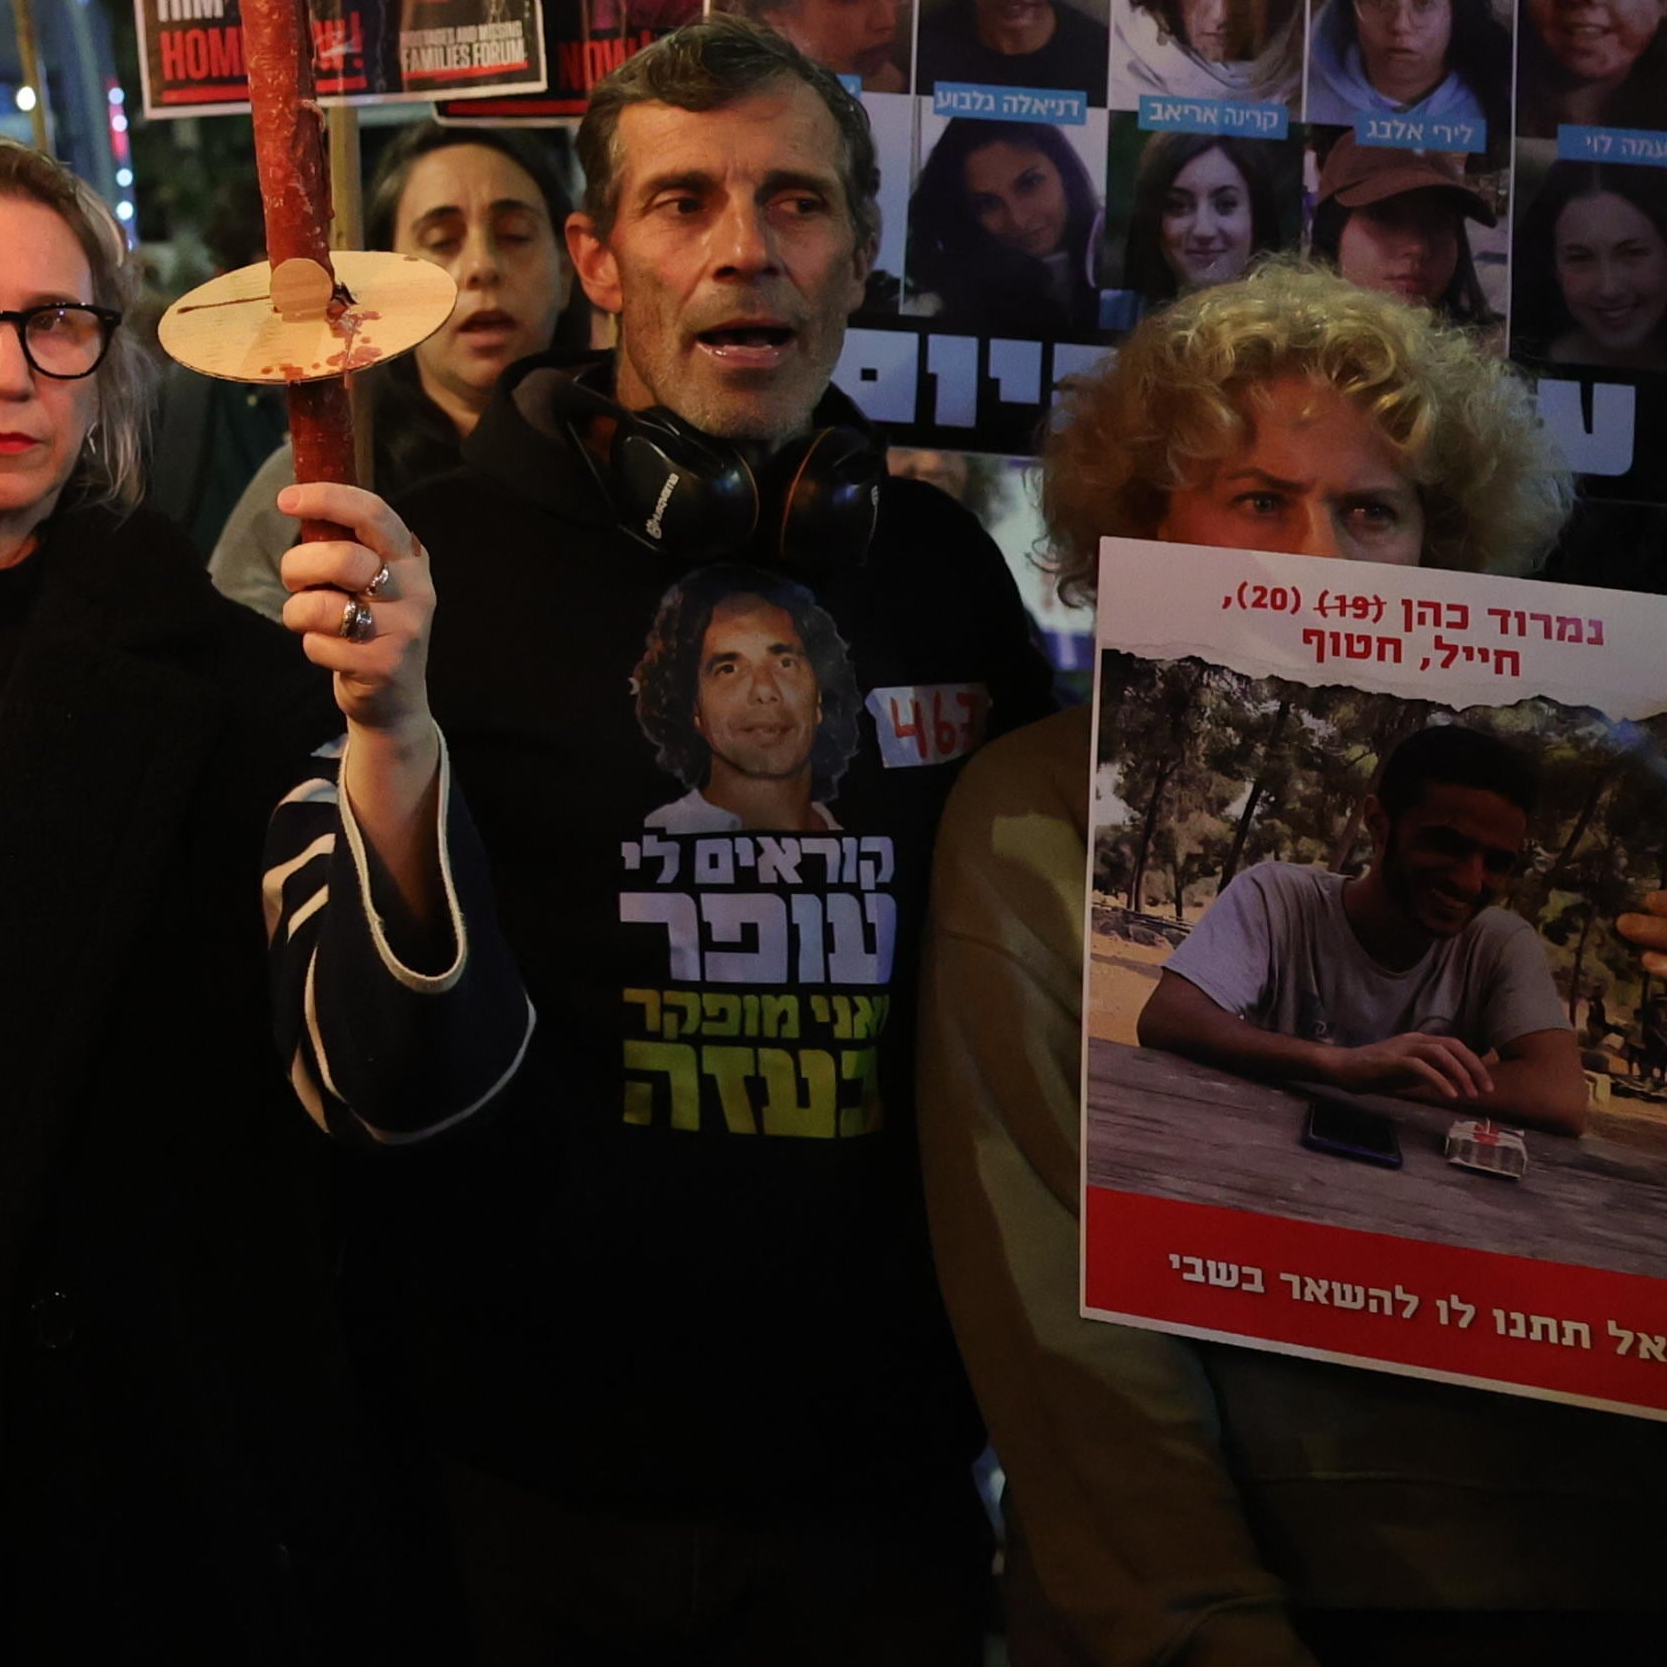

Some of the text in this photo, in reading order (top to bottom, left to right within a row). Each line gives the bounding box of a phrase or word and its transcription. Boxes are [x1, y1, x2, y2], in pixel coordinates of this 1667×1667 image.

[161, 28, 249, 81] HOM
[400, 38, 524, 73] FAMILIES FORUM
[935, 87, 1080, 119] דניאלה גלבוע
[1223, 106, 1279, 131] קרינה
[1367, 120, 1474, 147] לירי אלבג
[1585, 132, 1613, 153] לוי
[1221, 580, 1605, 646] נמרוד כהן (19) (20),
[1302, 627, 1521, 678] חייל, חטוף
[621, 834, 895, 891] קוראים לי
[619, 891, 898, 984] עופר
[622, 987, 800, 1039] מופקר
[1168, 1252, 1266, 1294] בשבי
[1279, 1271, 1420, 1319] להשאר
[1435, 1293, 1476, 1329] לו
[1492, 1307, 1592, 1350] תתנו
